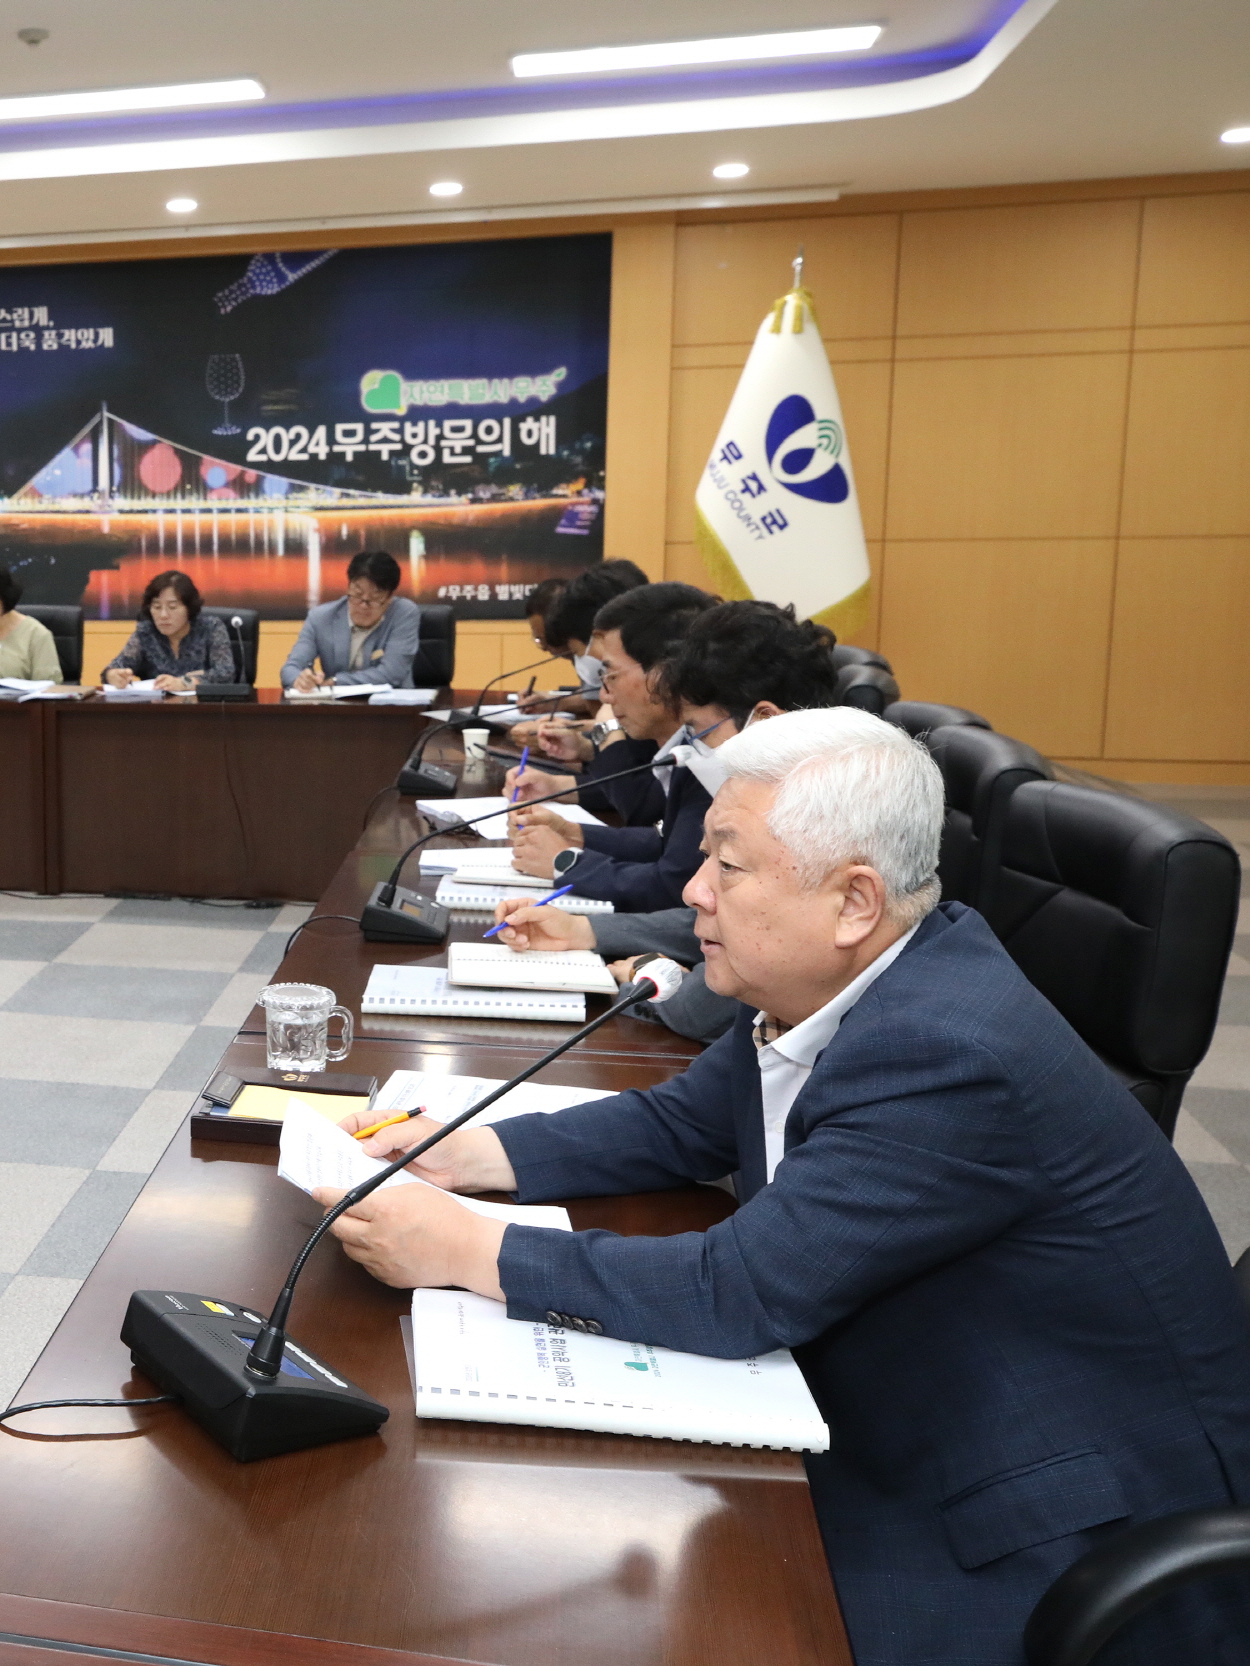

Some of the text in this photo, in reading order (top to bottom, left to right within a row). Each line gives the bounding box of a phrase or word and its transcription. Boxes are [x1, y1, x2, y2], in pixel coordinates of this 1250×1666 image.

[0, 330, 37, 352] 더욱
[41, 327, 114, 351] 품격있게
[519, 415, 556, 455] 해
